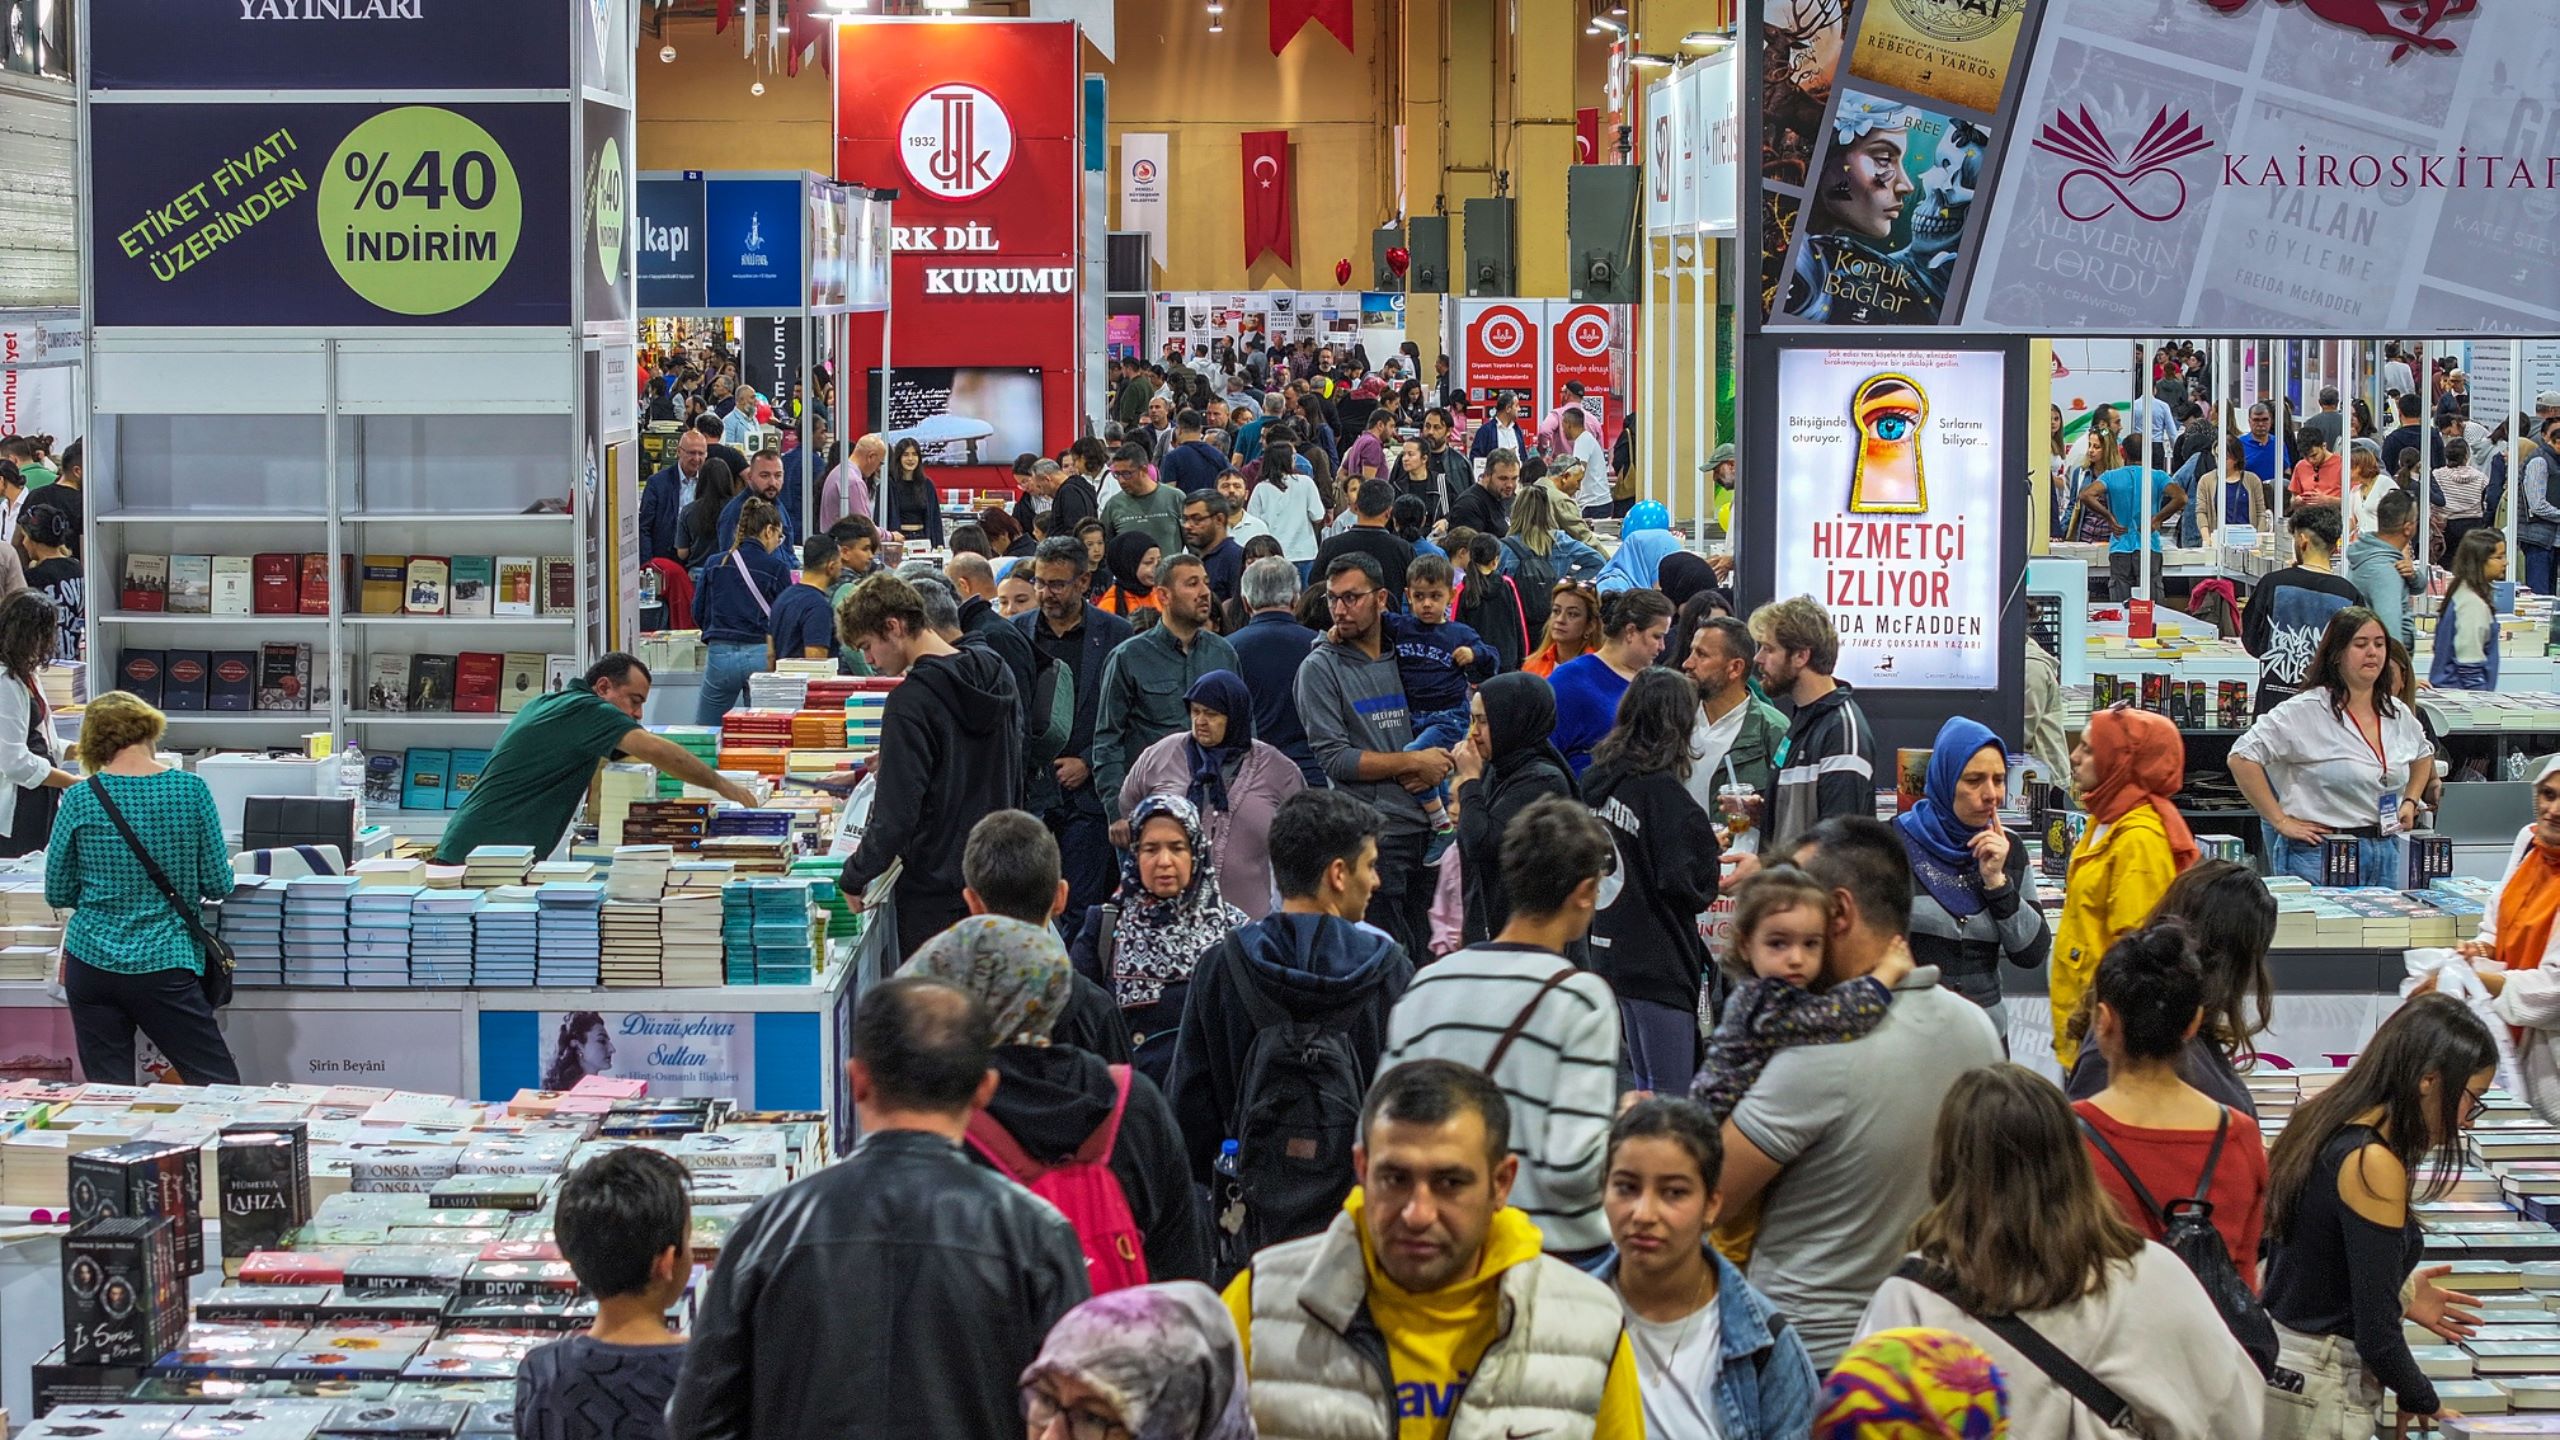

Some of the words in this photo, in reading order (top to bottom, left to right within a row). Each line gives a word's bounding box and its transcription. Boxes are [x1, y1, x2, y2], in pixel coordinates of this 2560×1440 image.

[240, 0, 423, 20] YAYINLARI
[1867, 35, 1933, 62] REBECCA
[1940, 54, 1997, 80] YARROS
[1903, 115, 1942, 137] BREE
[907, 136, 936, 147] 1932
[344, 150, 497, 211] %40
[118, 182, 207, 260] ETİKET
[212, 127, 299, 198] FİYATI
[149, 168, 308, 282] ÜZERİNDEN
[2267, 181, 2379, 247] YALAN
[645, 216, 689, 261] kapı
[890, 226, 938, 250] RK
[943, 220, 1000, 250] DİL
[2030, 206, 2180, 269] ALEVLERİN
[2453, 215, 2505, 242] KATE
[345, 223, 497, 261] İNDİRİM
[2245, 228, 2374, 282] SÖYLEME
[925, 268, 1074, 294] KURUMU
[2032, 238, 2173, 299] LORDU
[1824, 272, 1912, 314] Bağlar
[2062, 288, 2138, 318] CRAWFORD
[2235, 268, 2285, 295] FREIDA
[2289, 284, 2363, 317] McFADDEN
[1890, 359, 1900, 367] bir
[1789, 415, 1847, 430] Bitişiğinde
[1939, 417, 1983, 430] Sırlarını
[1792, 433, 1842, 446] oturuyor.
[1942, 433, 1989, 447] biliyor...
[1812, 512, 1965, 569] HİZMETÇİ
[502, 564, 533, 574] ROMA
[1826, 560, 1949, 608] İZLİYOR
[1876, 614, 1981, 636] McFADDEN
[1852, 638, 1882, 648] TIMES
[1887, 639, 1939, 650] ÇOKSATAN
[1945, 639, 1981, 649] YAZARI
[618, 1012, 736, 1038] Dürrüşehvar
[308, 1058, 340, 1074] Şirin
[646, 1044, 708, 1067] Sultan
[698, 1071, 740, 1084] İlişkileri
[370, 1164, 421, 1178] ONSRA
[476, 1164, 526, 1175] ONSRA
[696, 1156, 737, 1168] ONSRA
[371, 1180, 422, 1193] ONSRA
[226, 1191, 287, 1216] LAHZA
